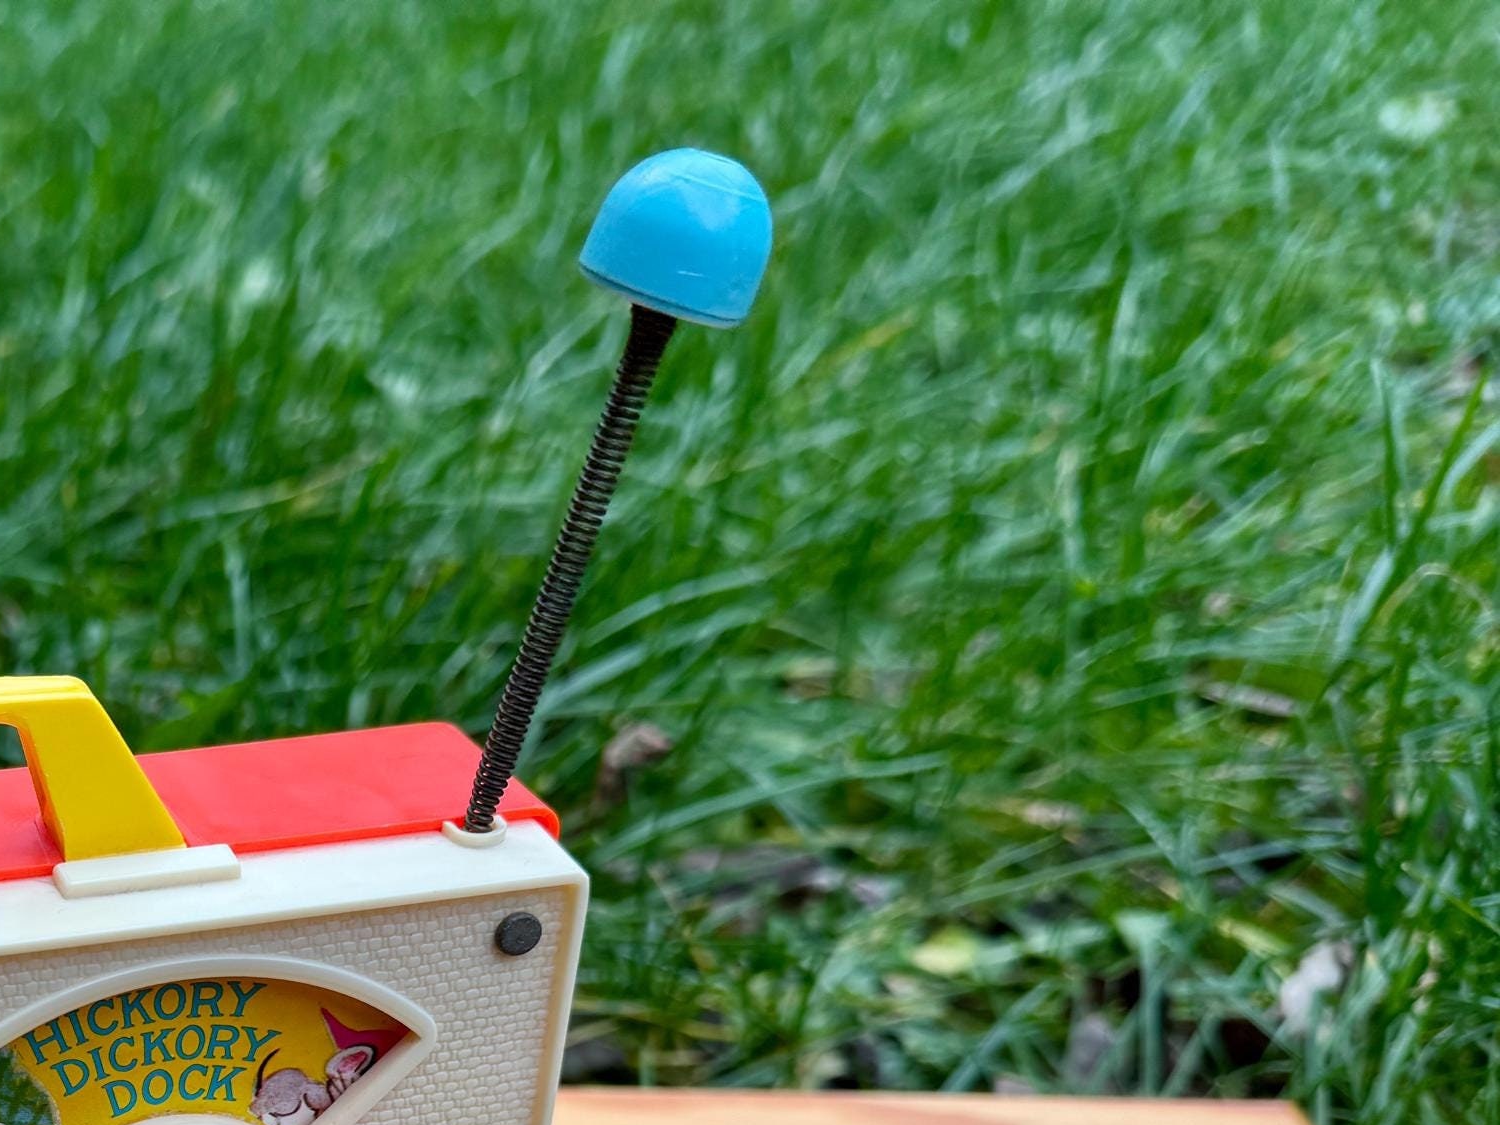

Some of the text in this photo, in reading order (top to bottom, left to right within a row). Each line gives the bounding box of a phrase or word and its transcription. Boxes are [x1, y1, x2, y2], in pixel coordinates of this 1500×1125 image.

[22, 980, 267, 1065] HICKORY
[50, 1024, 282, 1097] DICKORY
[101, 1063, 247, 1118] DOCK
